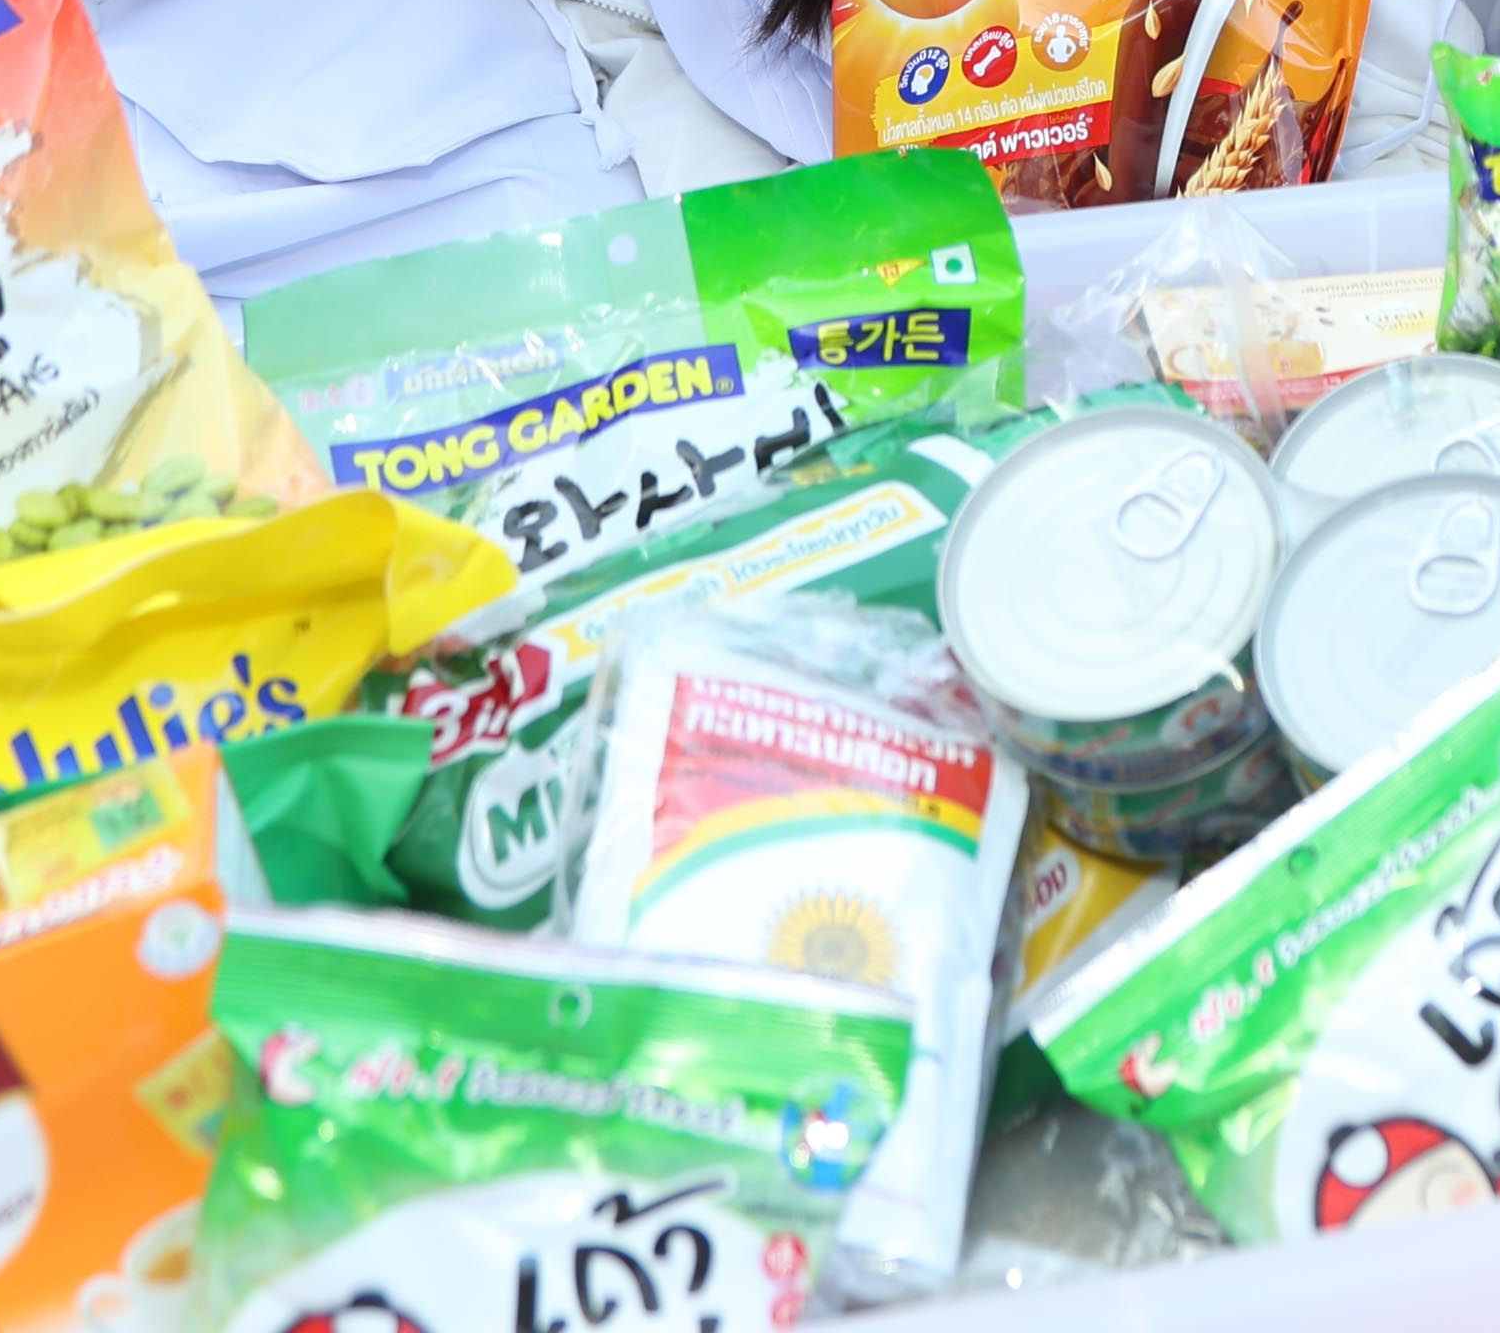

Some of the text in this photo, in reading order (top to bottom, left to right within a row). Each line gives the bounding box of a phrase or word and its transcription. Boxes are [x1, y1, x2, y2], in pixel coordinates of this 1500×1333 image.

[956, 108, 973, 123] 14
[1000, 99, 1018, 117] ต่อ
[352, 428, 500, 497] TONG
[507, 355, 714, 453] GARDEN
